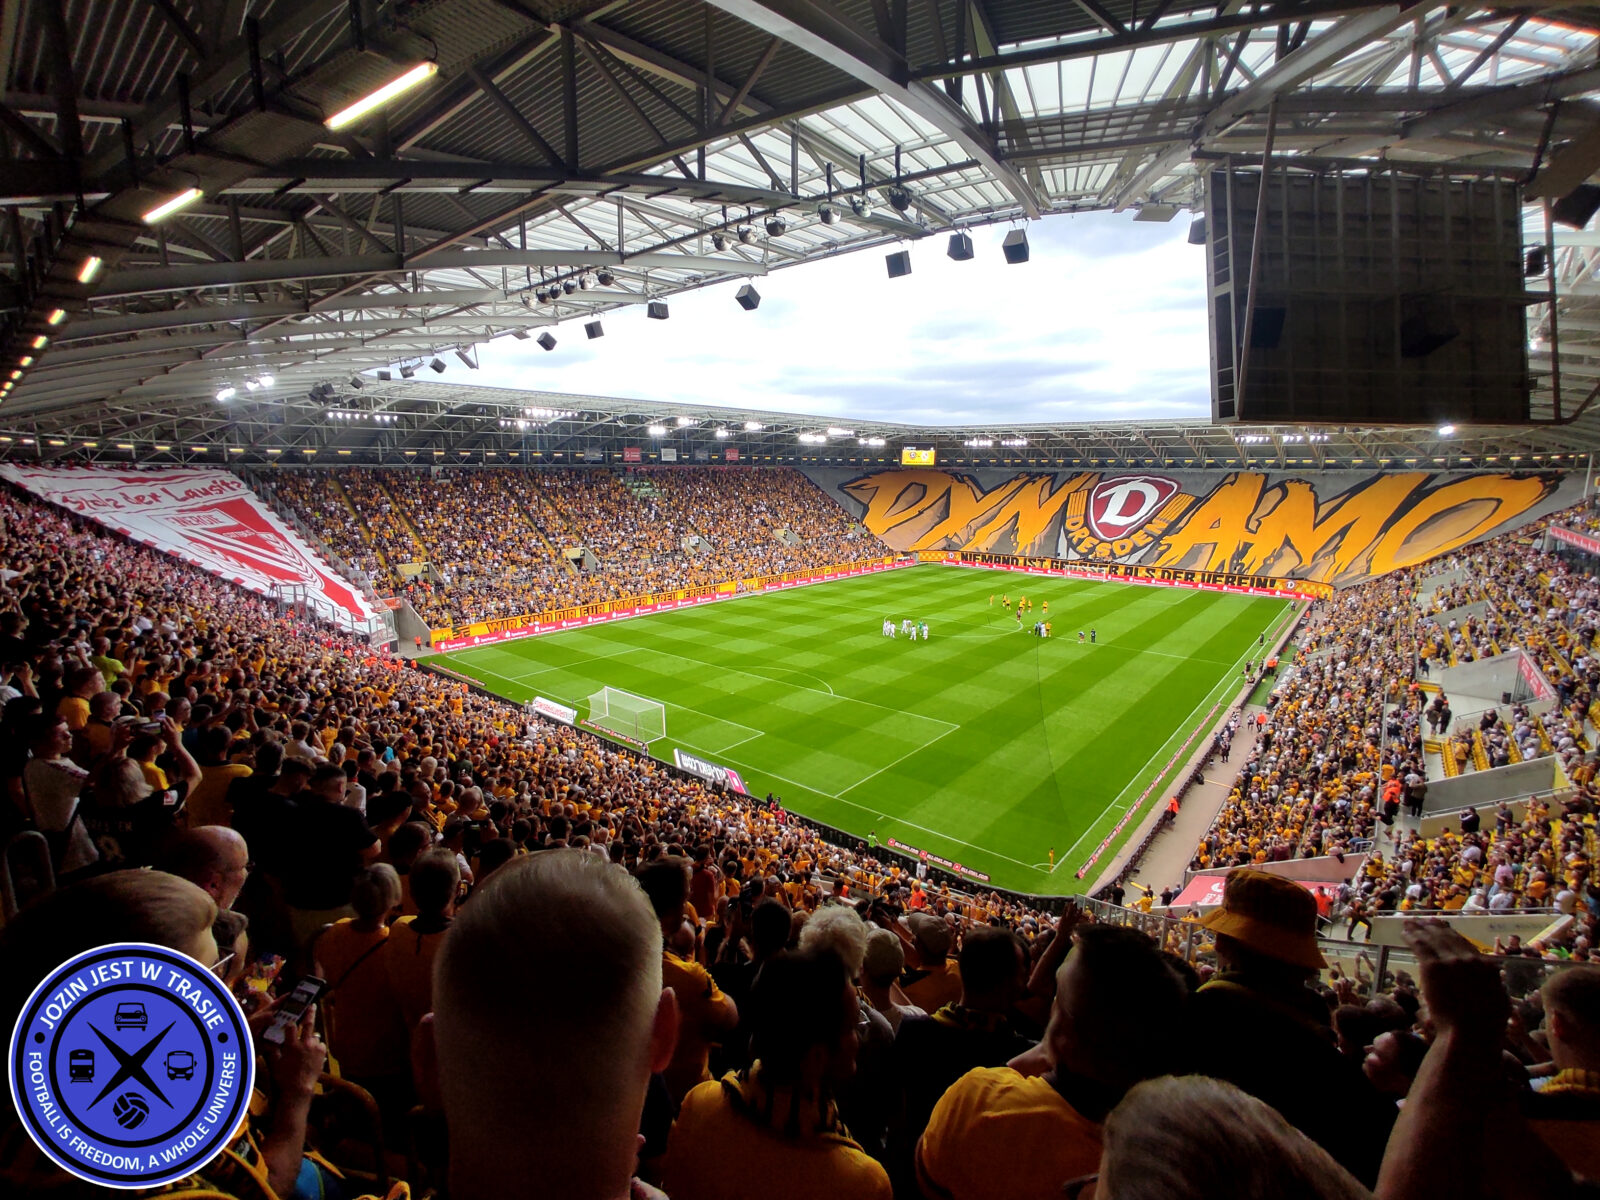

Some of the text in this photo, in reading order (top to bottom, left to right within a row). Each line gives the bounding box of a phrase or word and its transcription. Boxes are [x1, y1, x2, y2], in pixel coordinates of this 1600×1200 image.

[119, 491, 161, 505] der
[160, 479, 242, 501] Lausitz
[1065, 516, 1169, 558] DRESDEN
[960, 551, 1019, 567] NIEMAND
[1023, 557, 1047, 570] IST
[1124, 565, 1156, 579] ALS
[1160, 569, 1196, 582] DER
[487, 619, 518, 634] WIR
[521, 612, 551, 629] SIND
[609, 595, 648, 613] IMMER
